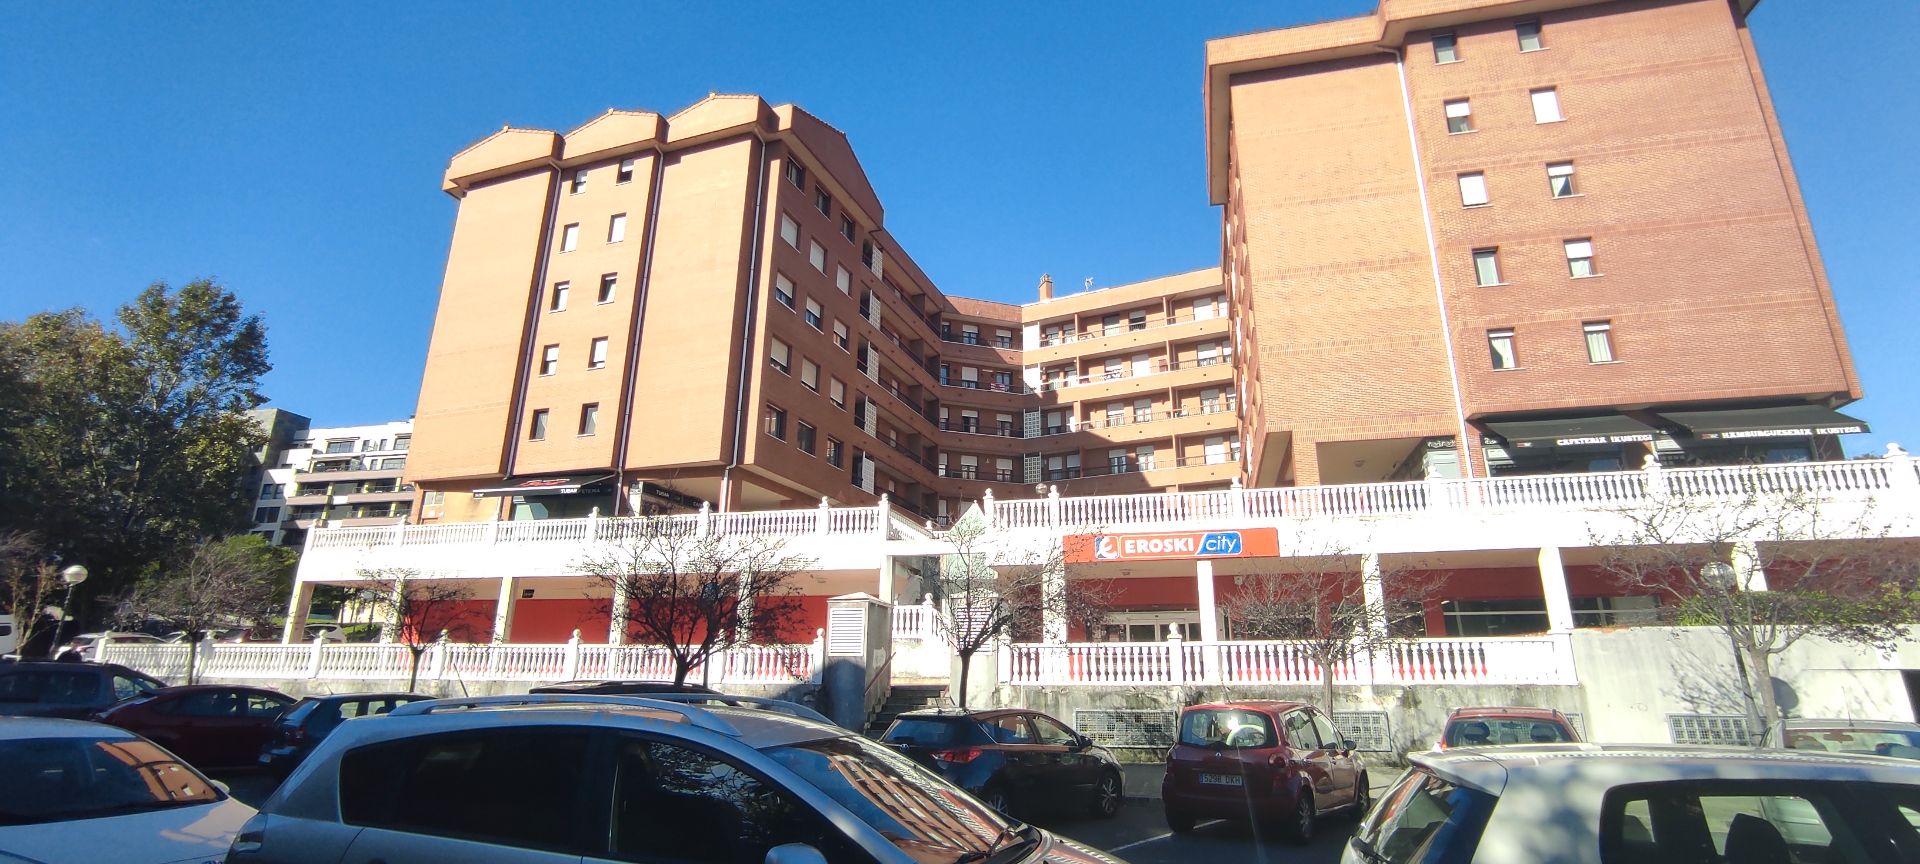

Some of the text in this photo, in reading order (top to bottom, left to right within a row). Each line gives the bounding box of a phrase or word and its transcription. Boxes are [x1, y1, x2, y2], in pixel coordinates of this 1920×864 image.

[1556, 436, 1607, 446] CAFETERIA
[1125, 534, 1238, 554] EROSKI city
